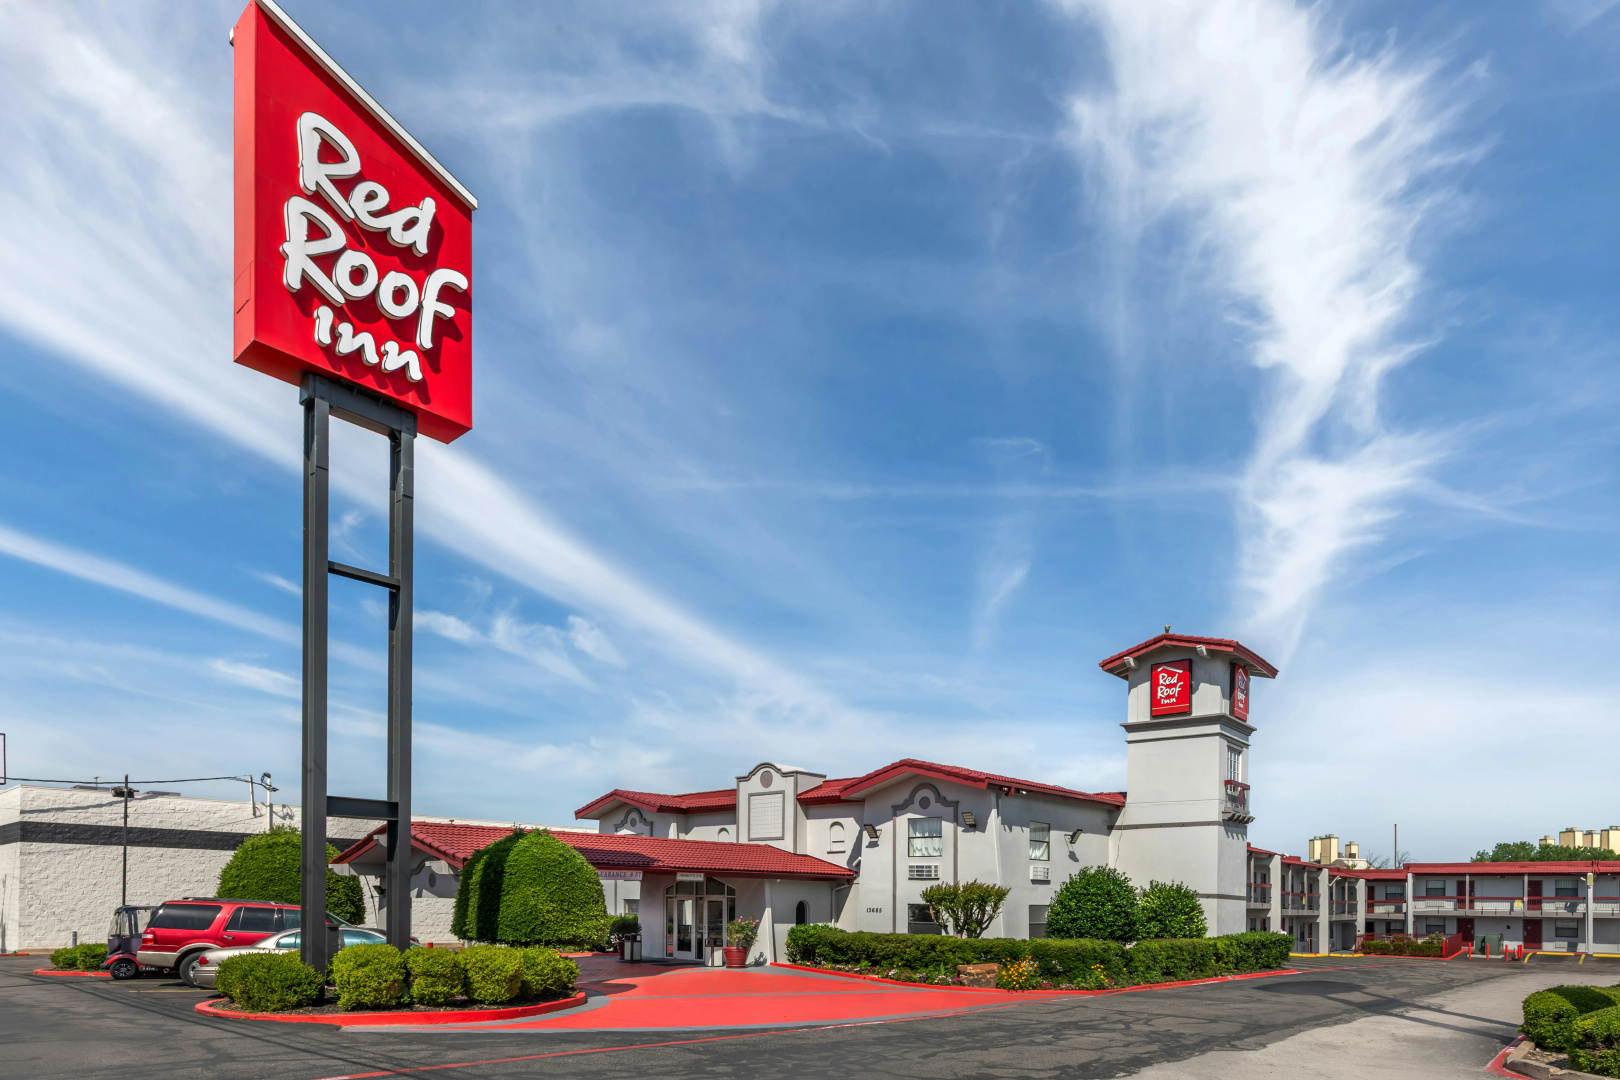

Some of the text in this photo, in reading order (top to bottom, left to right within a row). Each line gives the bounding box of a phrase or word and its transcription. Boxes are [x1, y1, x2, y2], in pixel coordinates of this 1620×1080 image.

[297, 111, 436, 257] Red
[280, 195, 468, 351] Roof
[1157, 681, 1184, 699] Roof
[1159, 673, 1178, 685] Red
